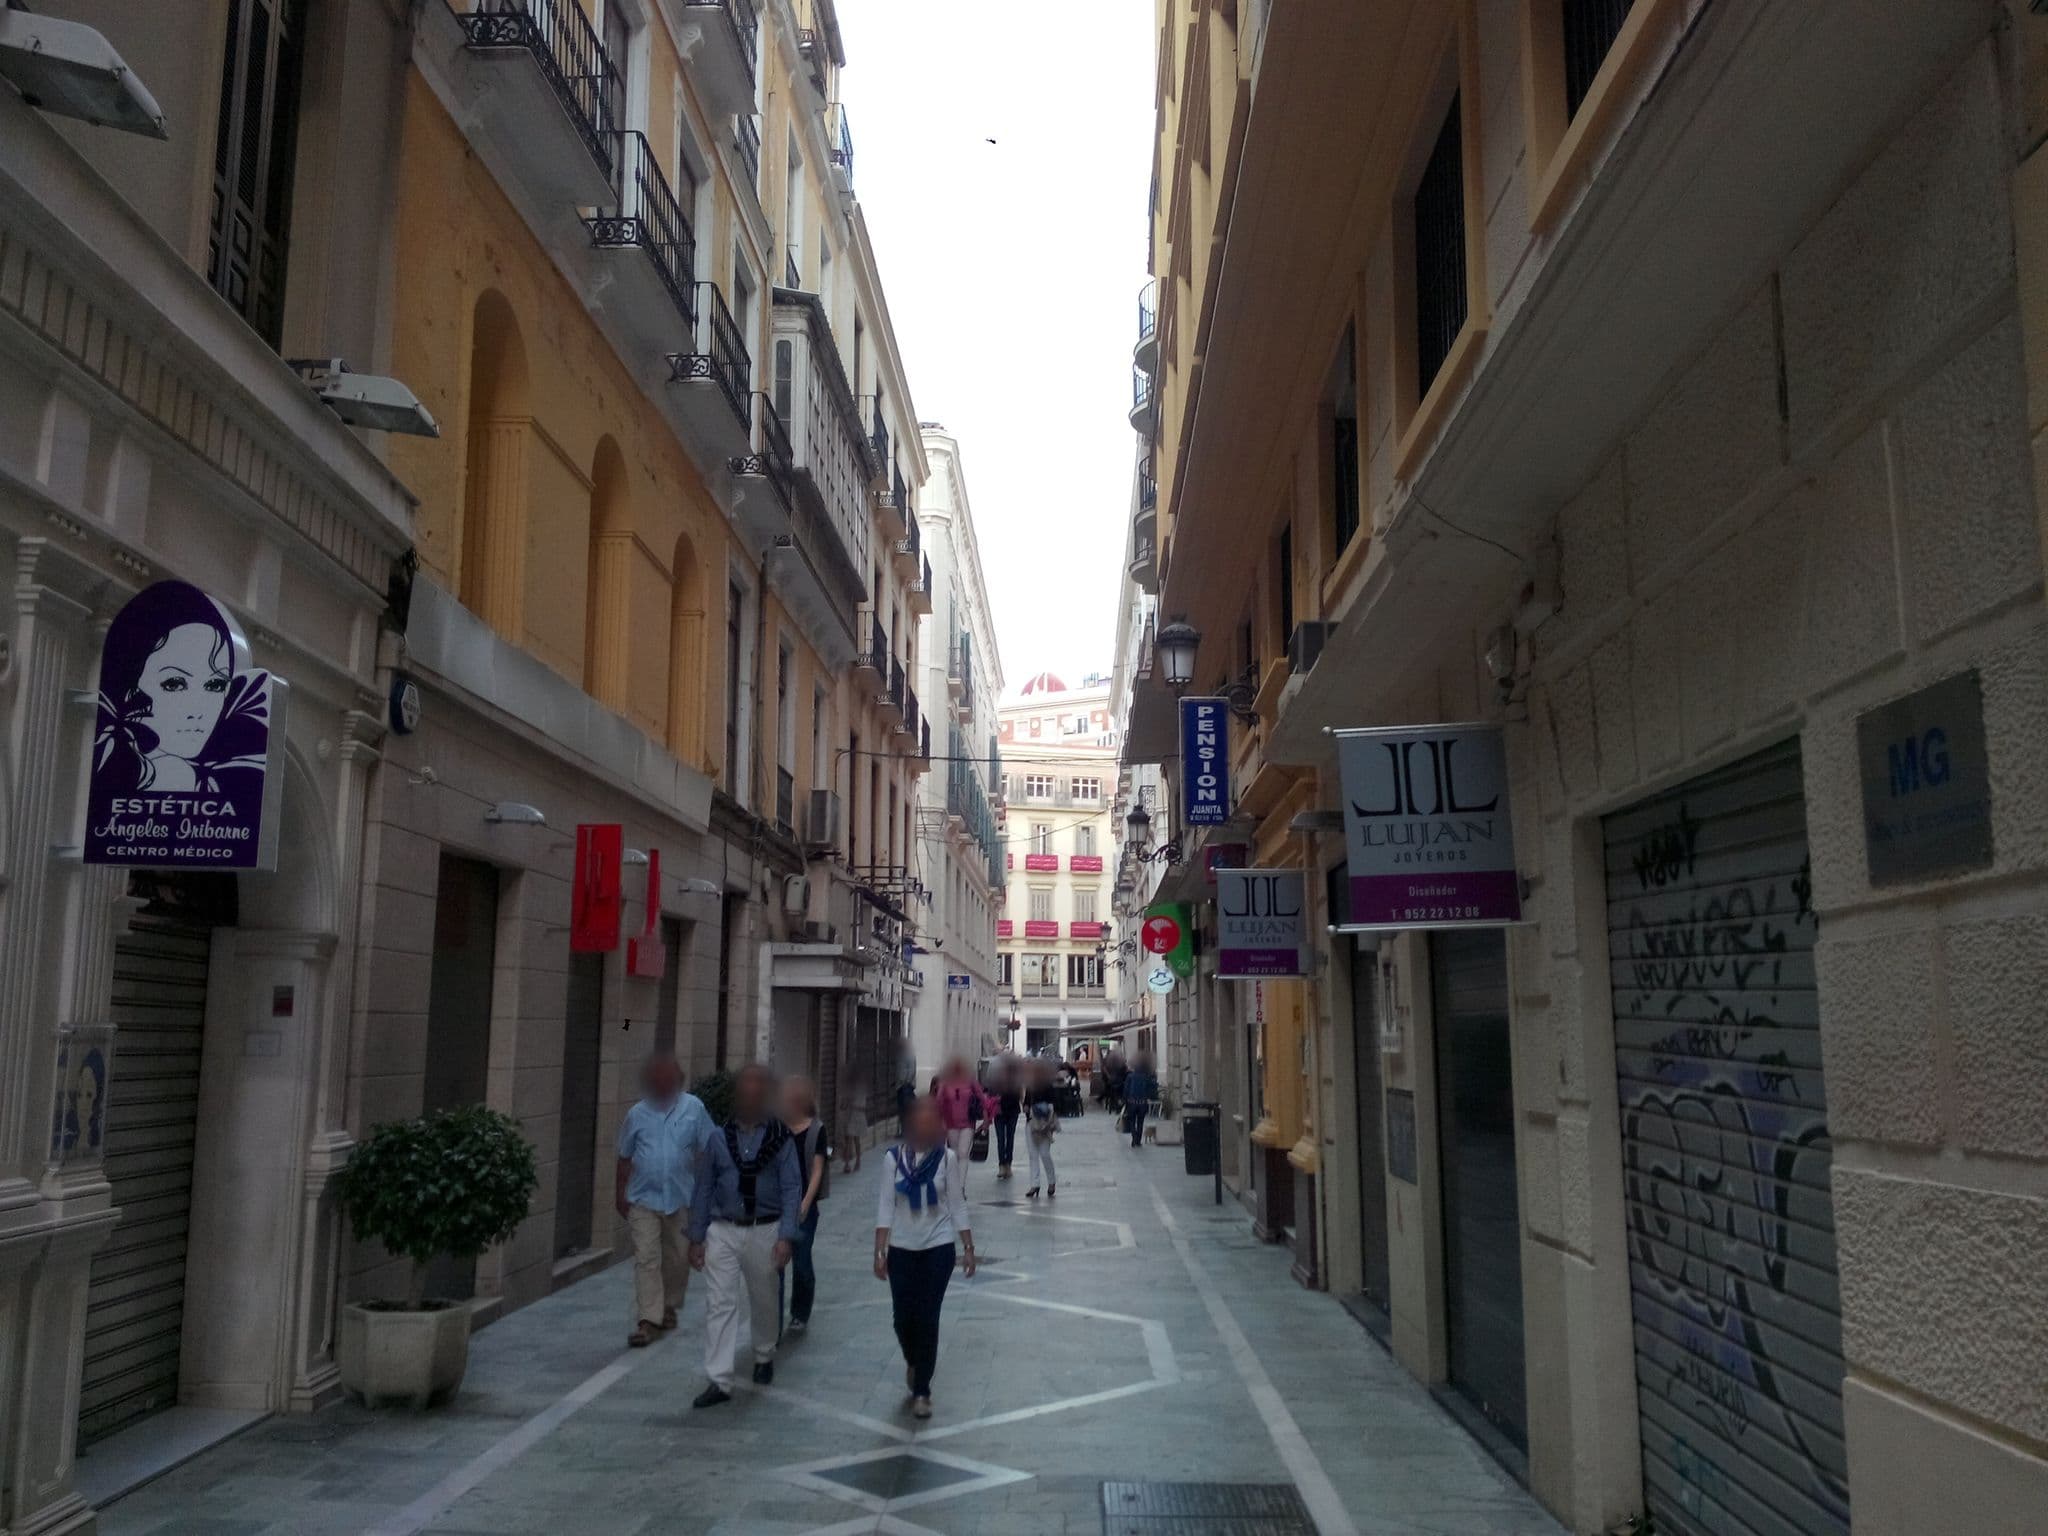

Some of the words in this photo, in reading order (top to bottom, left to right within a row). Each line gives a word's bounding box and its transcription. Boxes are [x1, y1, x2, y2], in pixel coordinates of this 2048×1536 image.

[1197, 706, 1217, 801] PENSION
[1888, 727, 1950, 798] MG
[111, 795, 236, 816] ESTÉTICA
[1191, 804, 1222, 815] JUANITA
[94, 813, 169, 842] Ángeles
[176, 817, 250, 840] Iribarne
[1361, 820, 1494, 852] LUJAN
[106, 846, 168, 857] CENTRO
[173, 845, 233, 858] MÉDICO
[1393, 849, 1468, 864] JOYEROS
[1404, 907, 1426, 920] 952
[1430, 906, 1444, 919] 22
[1448, 906, 1462, 918] 12
